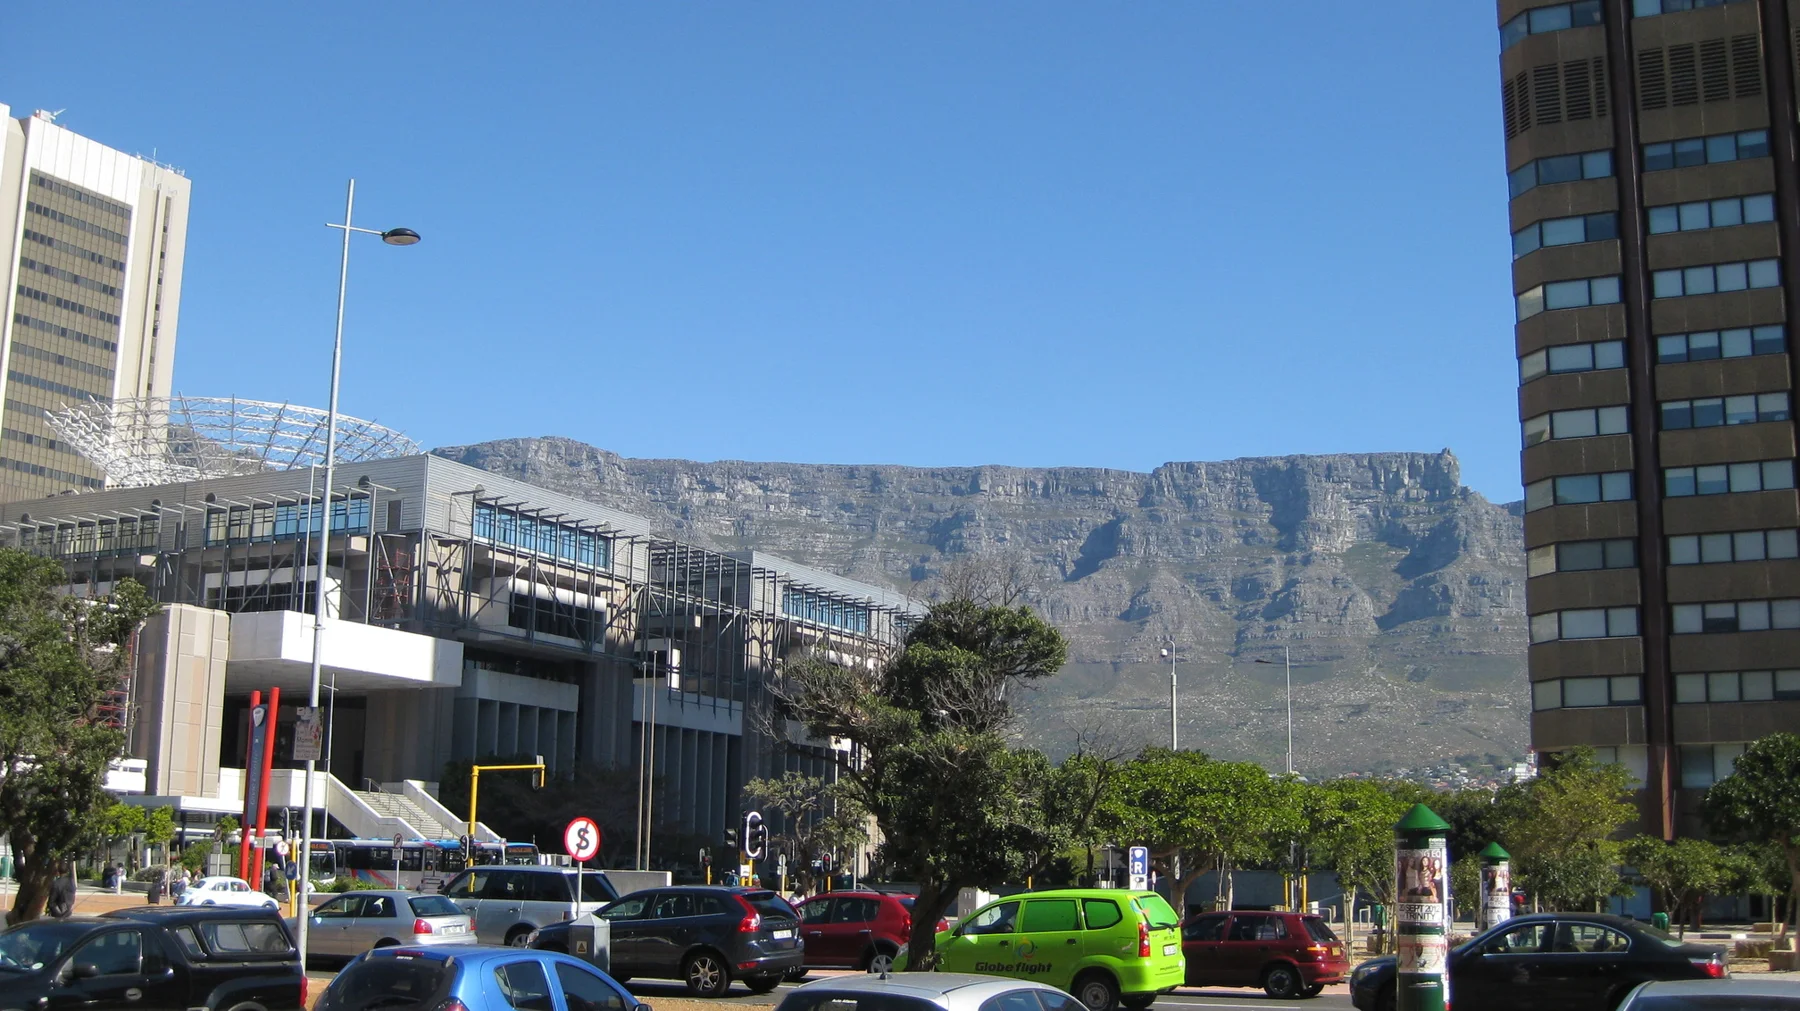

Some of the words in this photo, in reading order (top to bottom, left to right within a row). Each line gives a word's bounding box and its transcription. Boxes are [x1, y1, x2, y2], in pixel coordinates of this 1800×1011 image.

[1134, 861, 1143, 874] R
[1405, 904, 1423, 913] SEPT
[1425, 904, 1440, 913] 2012
[1406, 912, 1436, 920] TRINITY
